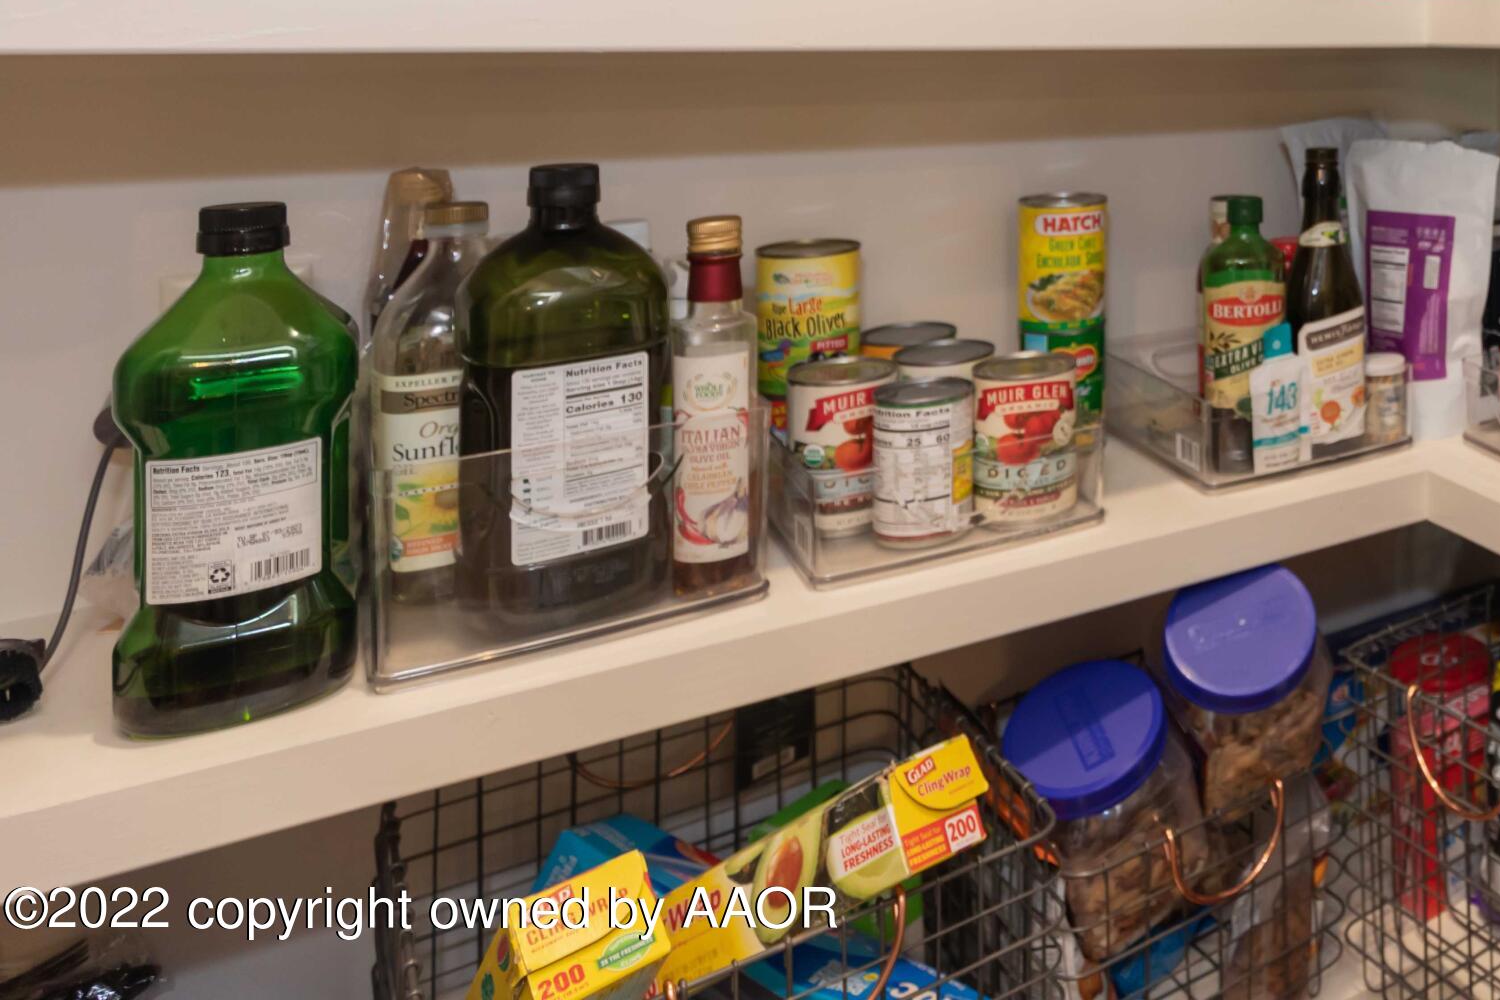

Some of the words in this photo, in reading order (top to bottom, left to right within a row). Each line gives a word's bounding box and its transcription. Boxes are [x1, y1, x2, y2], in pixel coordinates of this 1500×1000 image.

[1042, 213, 1101, 234] HATCH
[788, 296, 822, 316] Large
[1212, 301, 1282, 318] BERTOLLI
[765, 317, 801, 340] Black
[806, 312, 846, 337] Olives
[816, 339, 846, 350] PITTED
[565, 365, 612, 378] Nutrition
[615, 359, 643, 370] Facts
[395, 375, 447, 388] EXPELLER
[566, 399, 615, 414] Calories
[620, 391, 643, 404] 130
[823, 393, 866, 414] MUIR
[986, 387, 1025, 406] MUIR
[1032, 384, 1067, 399] GLEN
[1266, 382, 1298, 415] 143
[915, 408, 950, 417] Facts
[681, 424, 740, 442] ITALIAN
[907, 438, 921, 446] 25
[153, 466, 180, 475] Nutrition
[181, 465, 200, 474] Facts
[905, 757, 935, 784] GLAD
[947, 816, 977, 842] 200
[840, 826, 892, 858] LONG-LASTING
[843, 837, 894, 871] FRESHNESS
[537, 964, 586, 1000] 200
